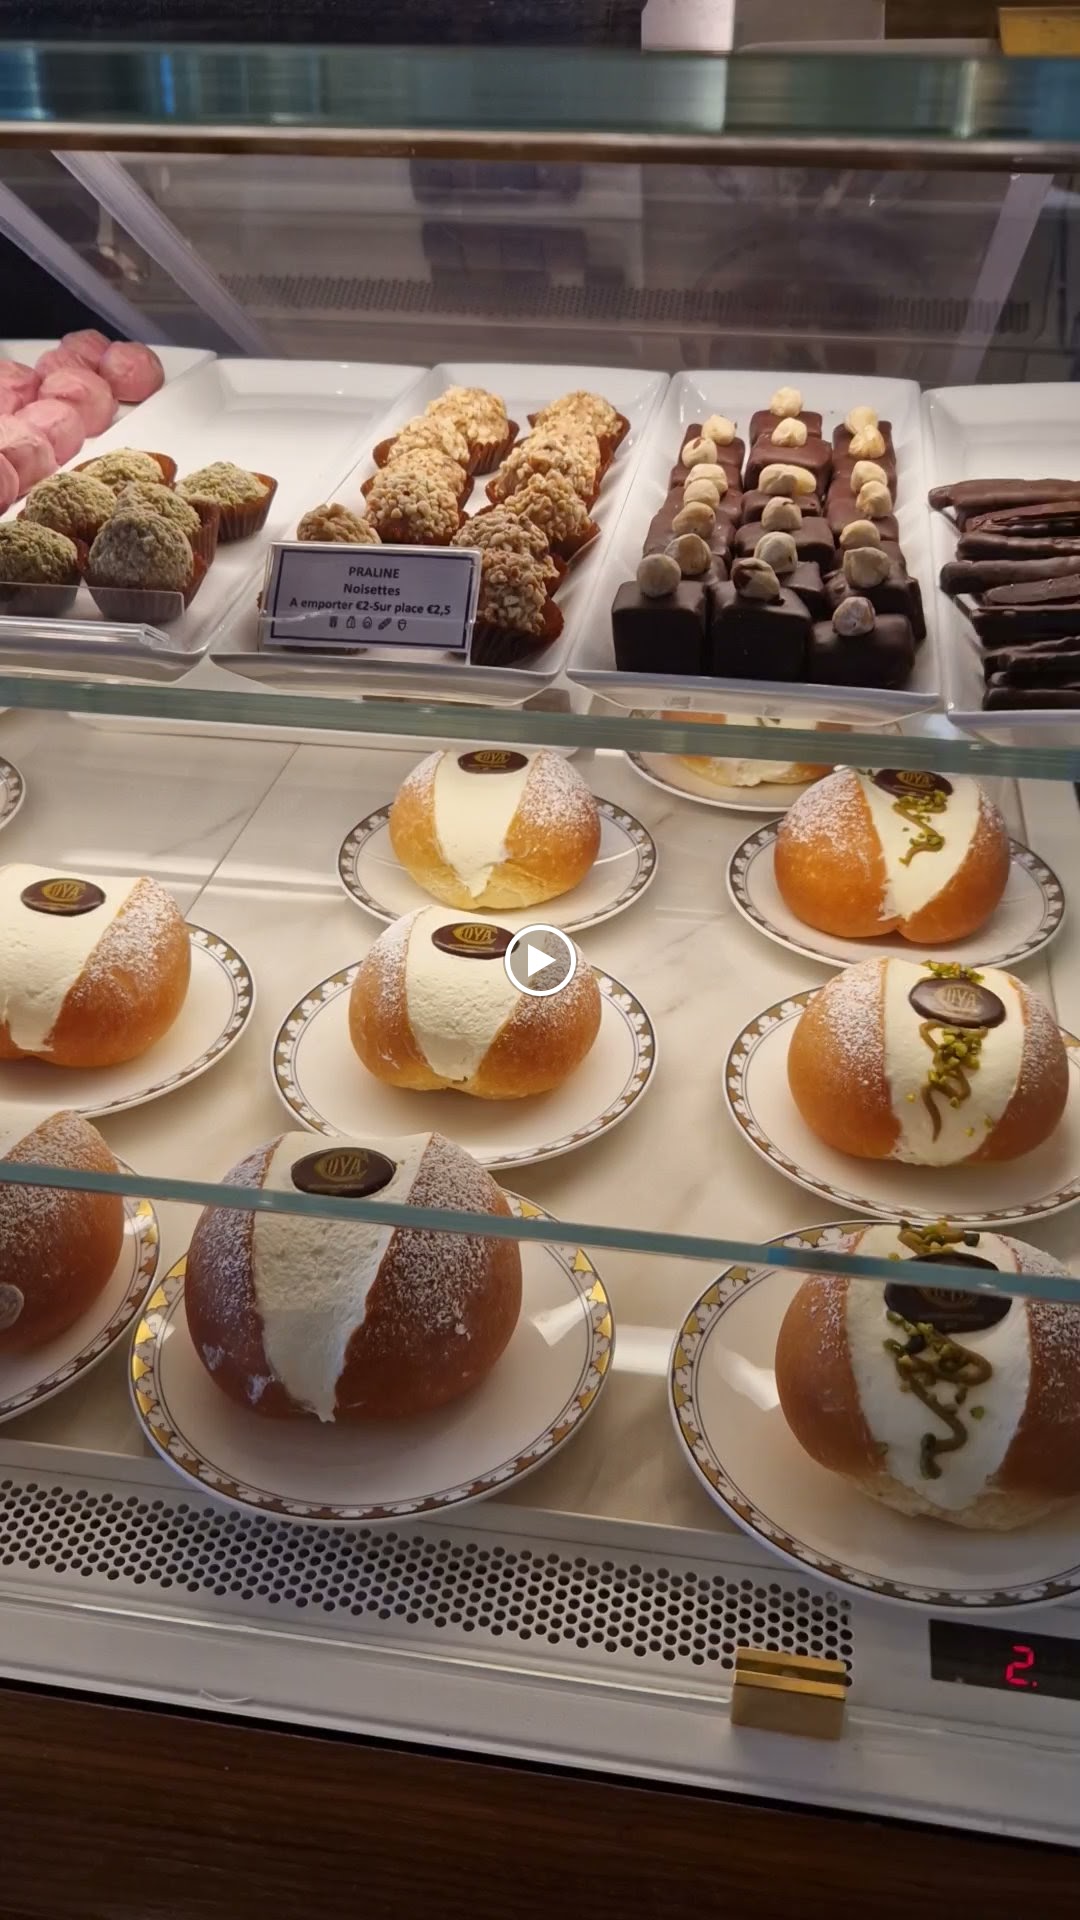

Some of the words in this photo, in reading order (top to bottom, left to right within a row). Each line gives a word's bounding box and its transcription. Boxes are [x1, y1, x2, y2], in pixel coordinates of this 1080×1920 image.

[348, 566, 400, 579] PRALINE
[343, 583, 400, 596] Noisettes
[289, 597, 298, 608] A
[300, 599, 353, 610] emporter
[394, 602, 424, 615] place
[427, 604, 451, 617] €2,5
